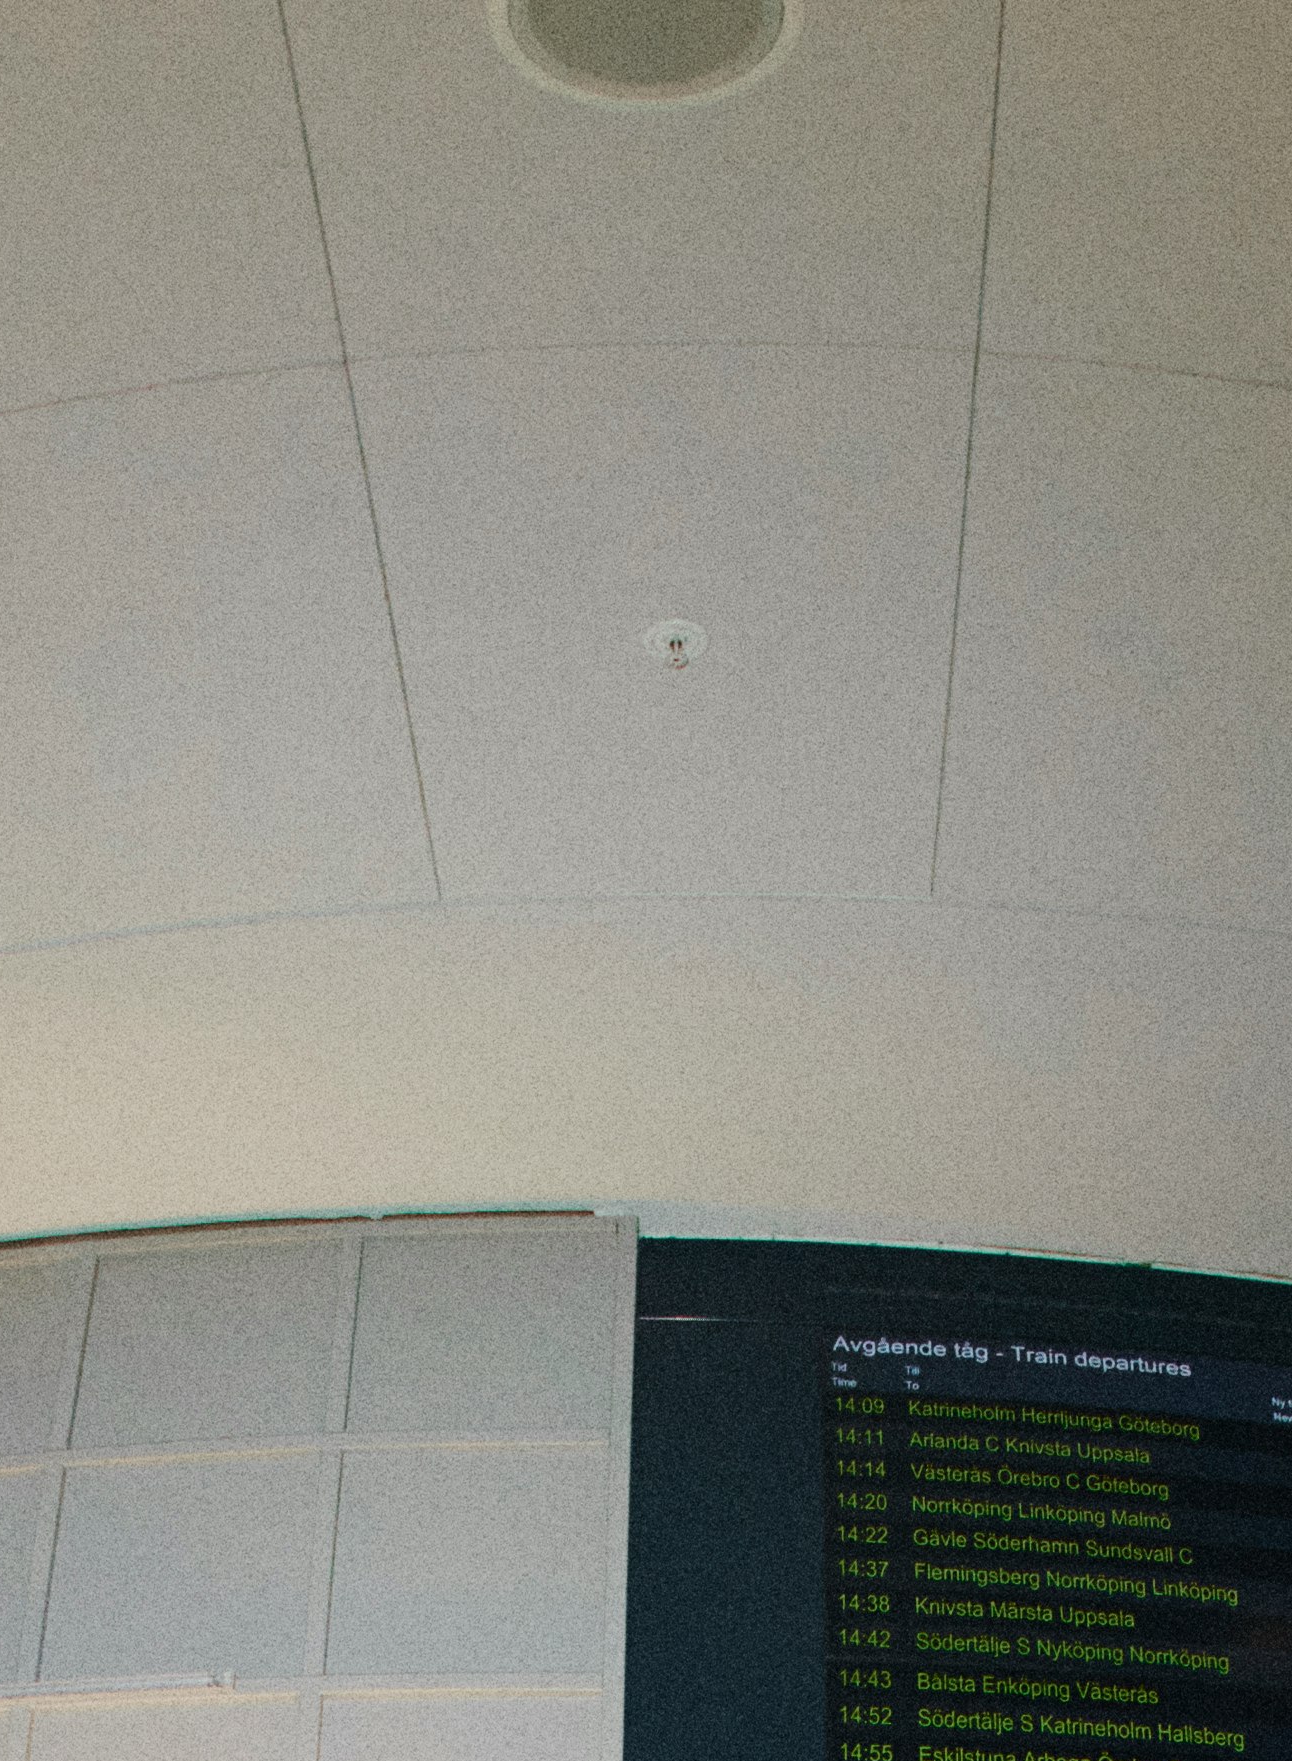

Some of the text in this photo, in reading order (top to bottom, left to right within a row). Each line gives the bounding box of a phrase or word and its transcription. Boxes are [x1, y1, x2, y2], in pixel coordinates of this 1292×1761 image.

[833, 1336, 1191, 1377] Avgående tåg Train departures
[836, 1397, 885, 1414] 14:09
[908, 1400, 1200, 1441] Katrineholm Herrljunga Göteborg
[837, 1428, 883, 1445] 14:11
[910, 1432, 1150, 1463] Arlanda C Knivsta Uppsala
[838, 1460, 886, 1477] 14:14
[911, 1464, 1169, 1501] Västerås Örebro C Göteborg
[838, 1493, 887, 1511] 14:20
[912, 1496, 1171, 1530] Norrköping Linköping Malmö
[838, 1526, 888, 1544] 14:22
[913, 1529, 1193, 1565] Gävle Söderhamn Sundsvall C
[839, 1559, 889, 1578] 14:37
[914, 1562, 1238, 1607] Flemingsberg Norrköping Linköping
[839, 1594, 890, 1613] 14:38
[915, 1597, 1135, 1628] Knivsta Märsta Uppsala
[840, 1629, 890, 1648] 14:42
[916, 1632, 1230, 1675] Södertälje S Nyköping Norrköping
[840, 1670, 892, 1689] 14:43
[917, 1672, 1159, 1704] Bålsta Enköping Västerås
[841, 1706, 892, 1725] 14:52
[918, 1708, 1244, 1752] Södertälje S Katrineholm Hallsberg
